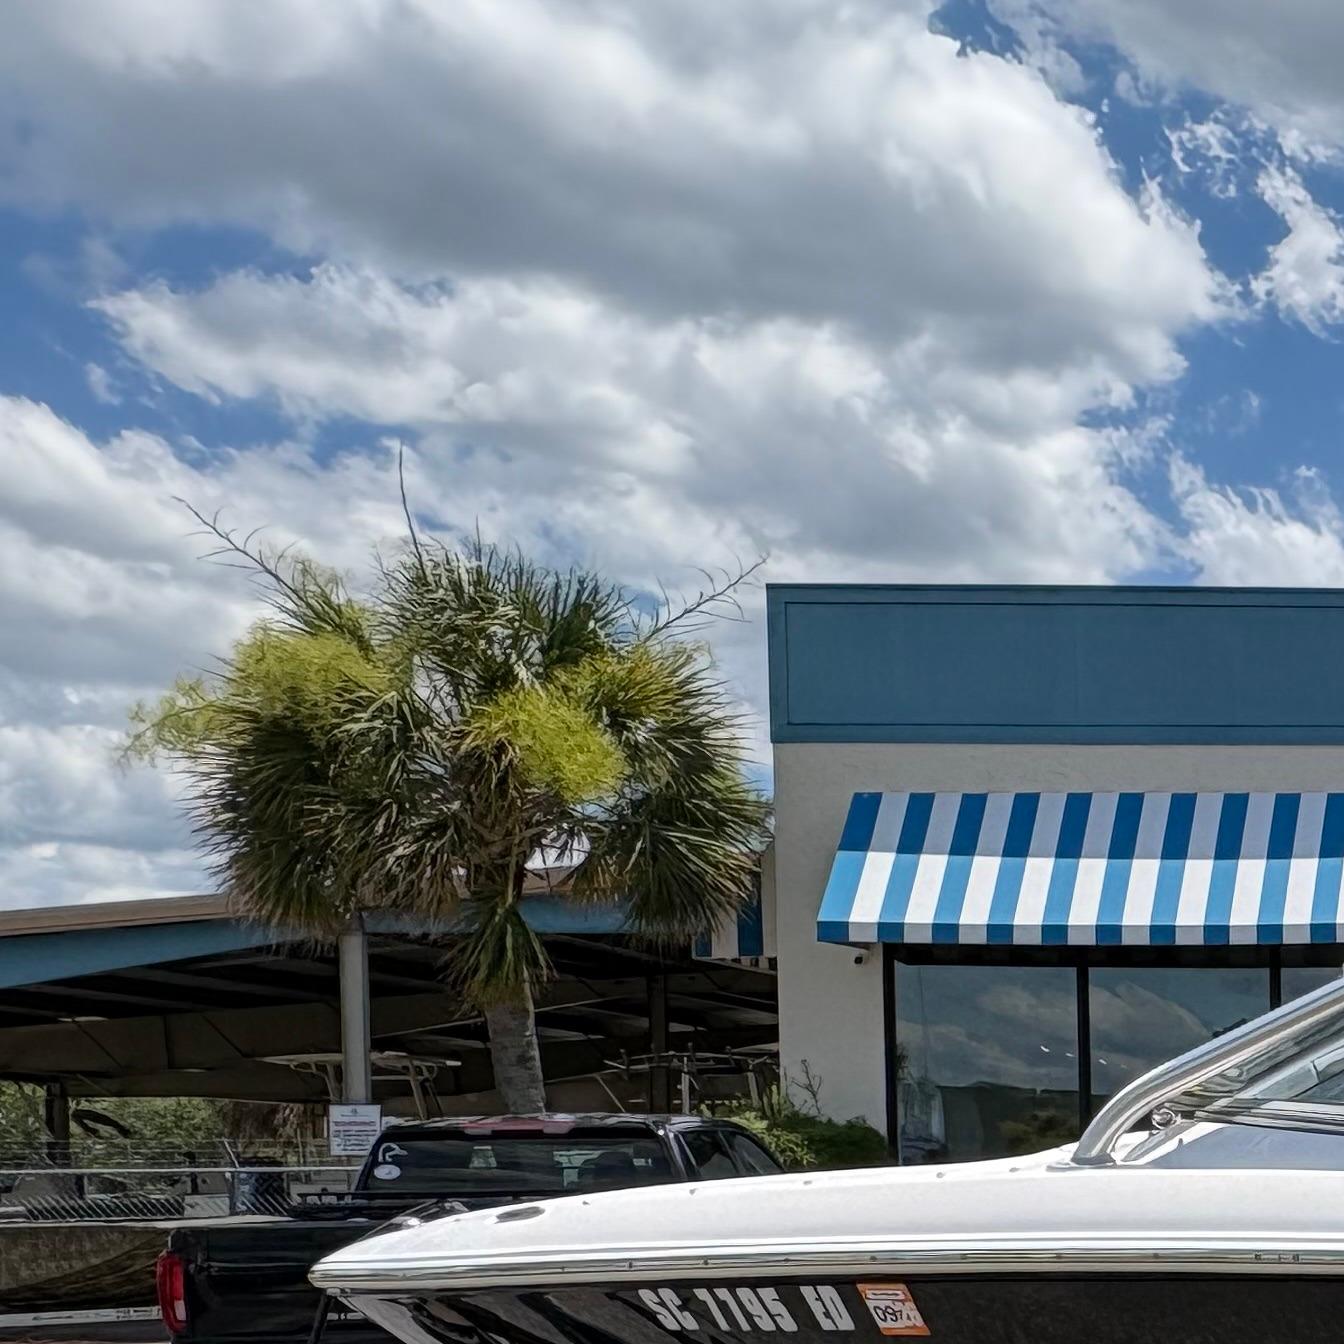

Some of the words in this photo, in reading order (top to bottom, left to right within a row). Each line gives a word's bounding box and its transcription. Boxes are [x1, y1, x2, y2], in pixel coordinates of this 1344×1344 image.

[637, 1287, 700, 1331] SC
[693, 1286, 798, 1332] 7795
[800, 1285, 855, 1331] ED
